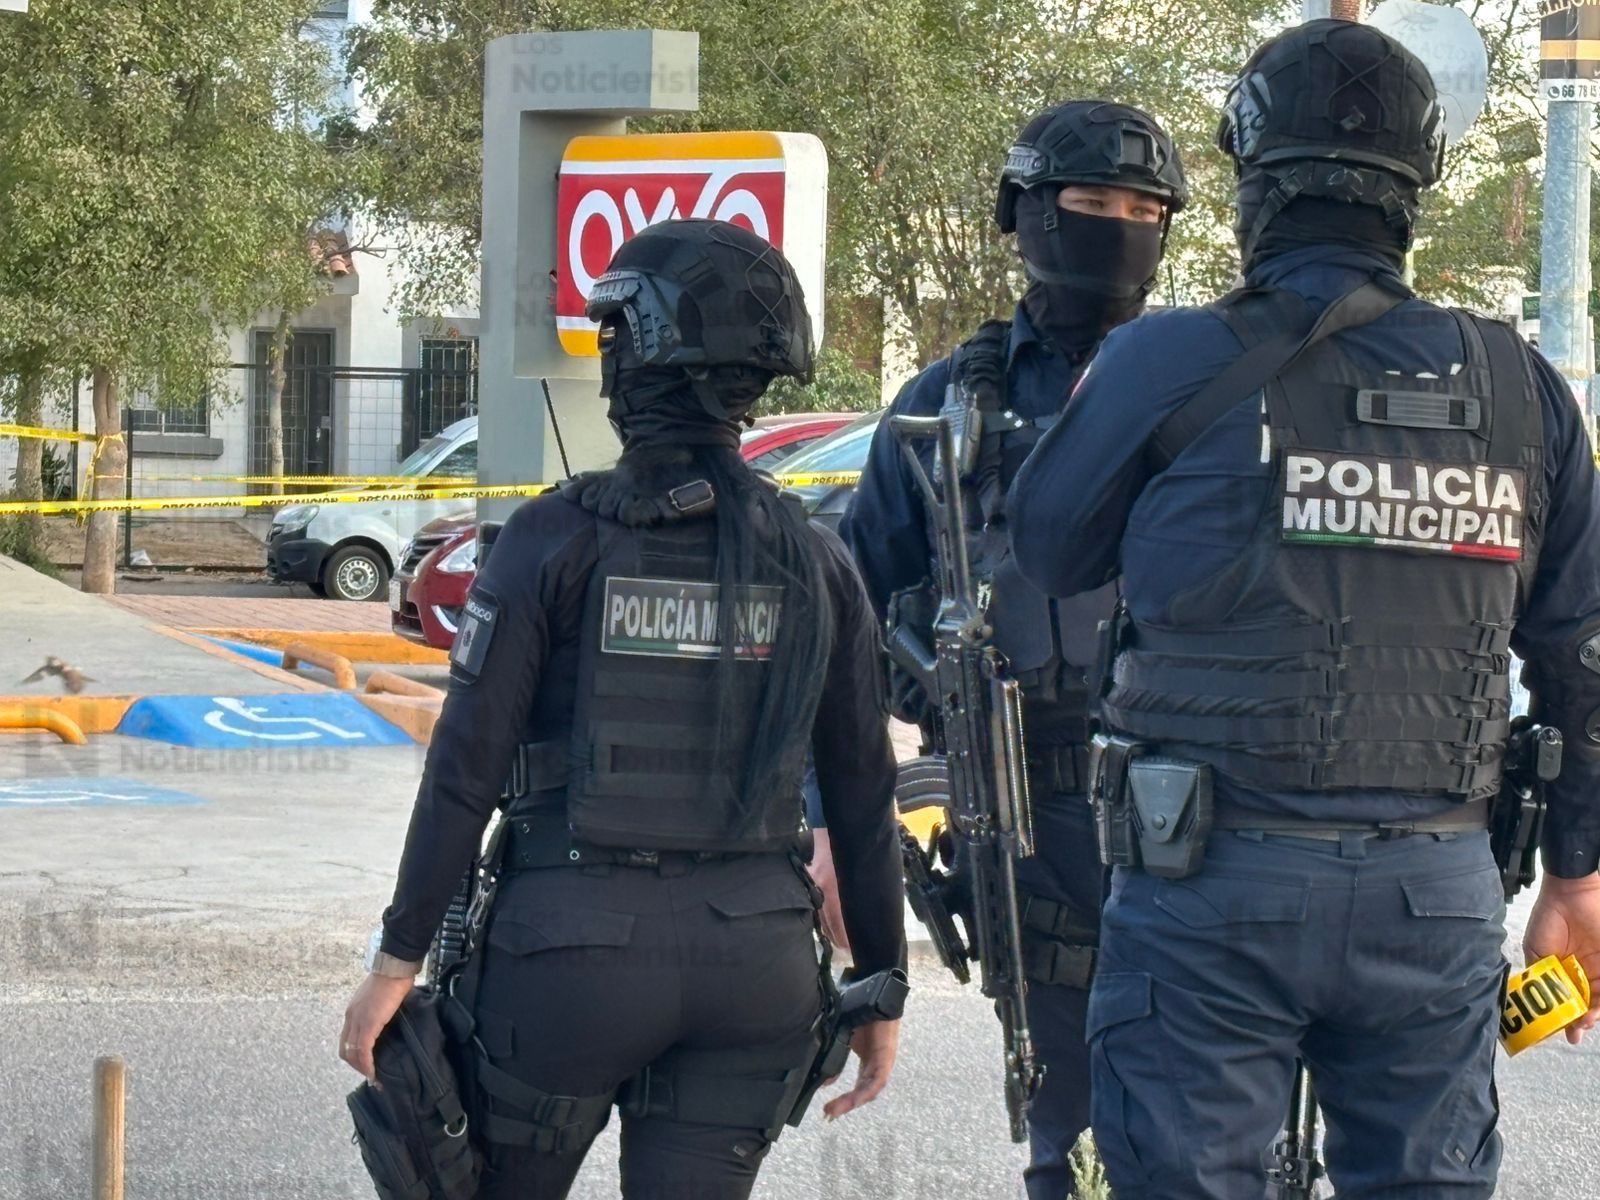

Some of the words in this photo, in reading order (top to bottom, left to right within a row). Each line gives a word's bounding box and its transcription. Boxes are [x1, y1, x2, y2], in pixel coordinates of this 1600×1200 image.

[1285, 455, 1522, 512] POLICÍA
[1282, 496, 1521, 548] MUNICIPAL
[609, 588, 698, 641] POLICÍA
